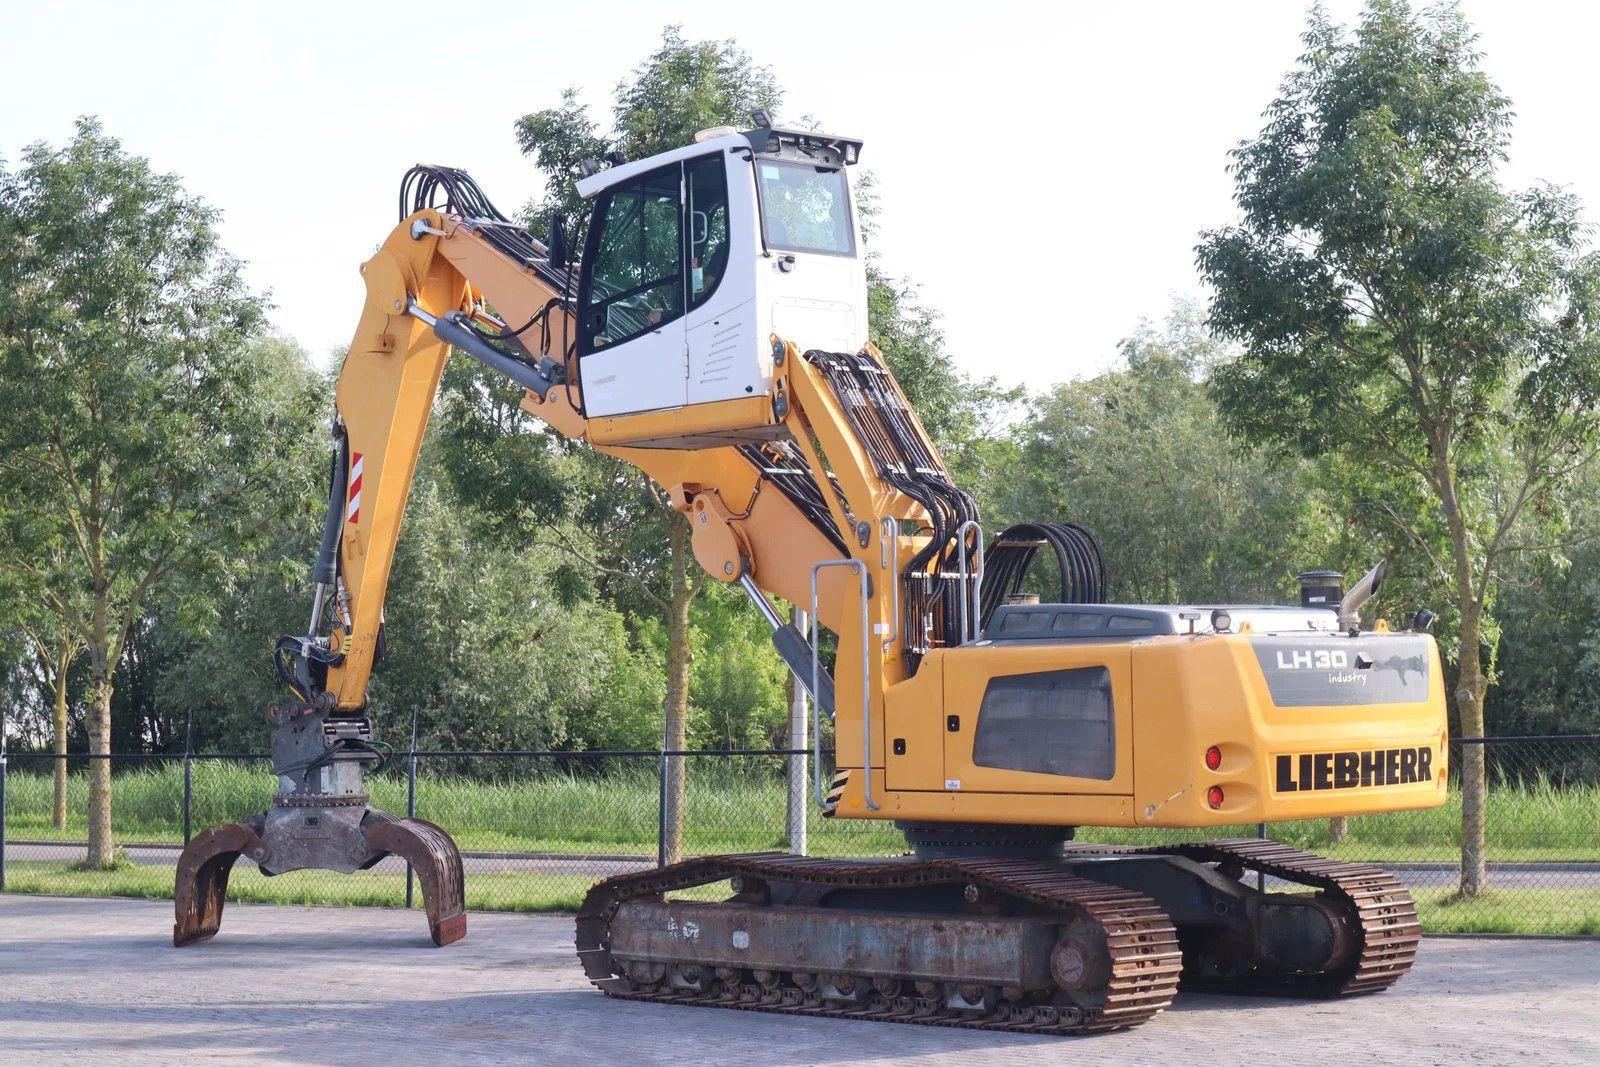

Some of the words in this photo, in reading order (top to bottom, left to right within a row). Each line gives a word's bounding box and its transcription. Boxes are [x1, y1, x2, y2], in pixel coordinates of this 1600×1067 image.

[1276, 650, 1348, 669] LH30
[1328, 671, 1367, 686] industry
[1276, 747, 1432, 792] LIEBHERR
